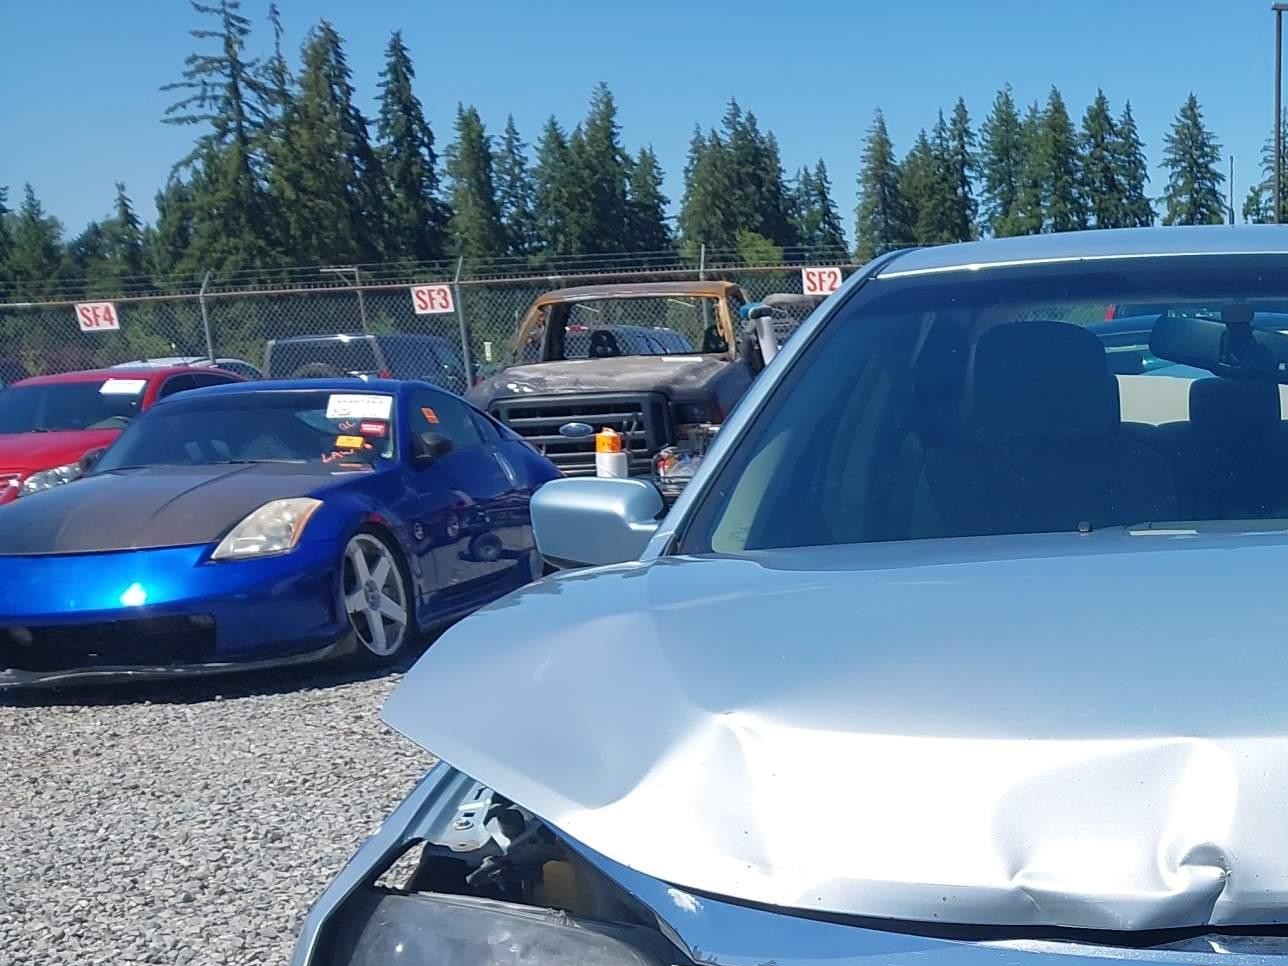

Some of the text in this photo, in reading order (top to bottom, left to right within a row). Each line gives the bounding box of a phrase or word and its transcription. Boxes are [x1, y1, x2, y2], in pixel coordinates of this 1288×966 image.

[806, 271, 840, 292] SF2
[415, 288, 450, 310] SF3
[80, 305, 114, 327] SF4
